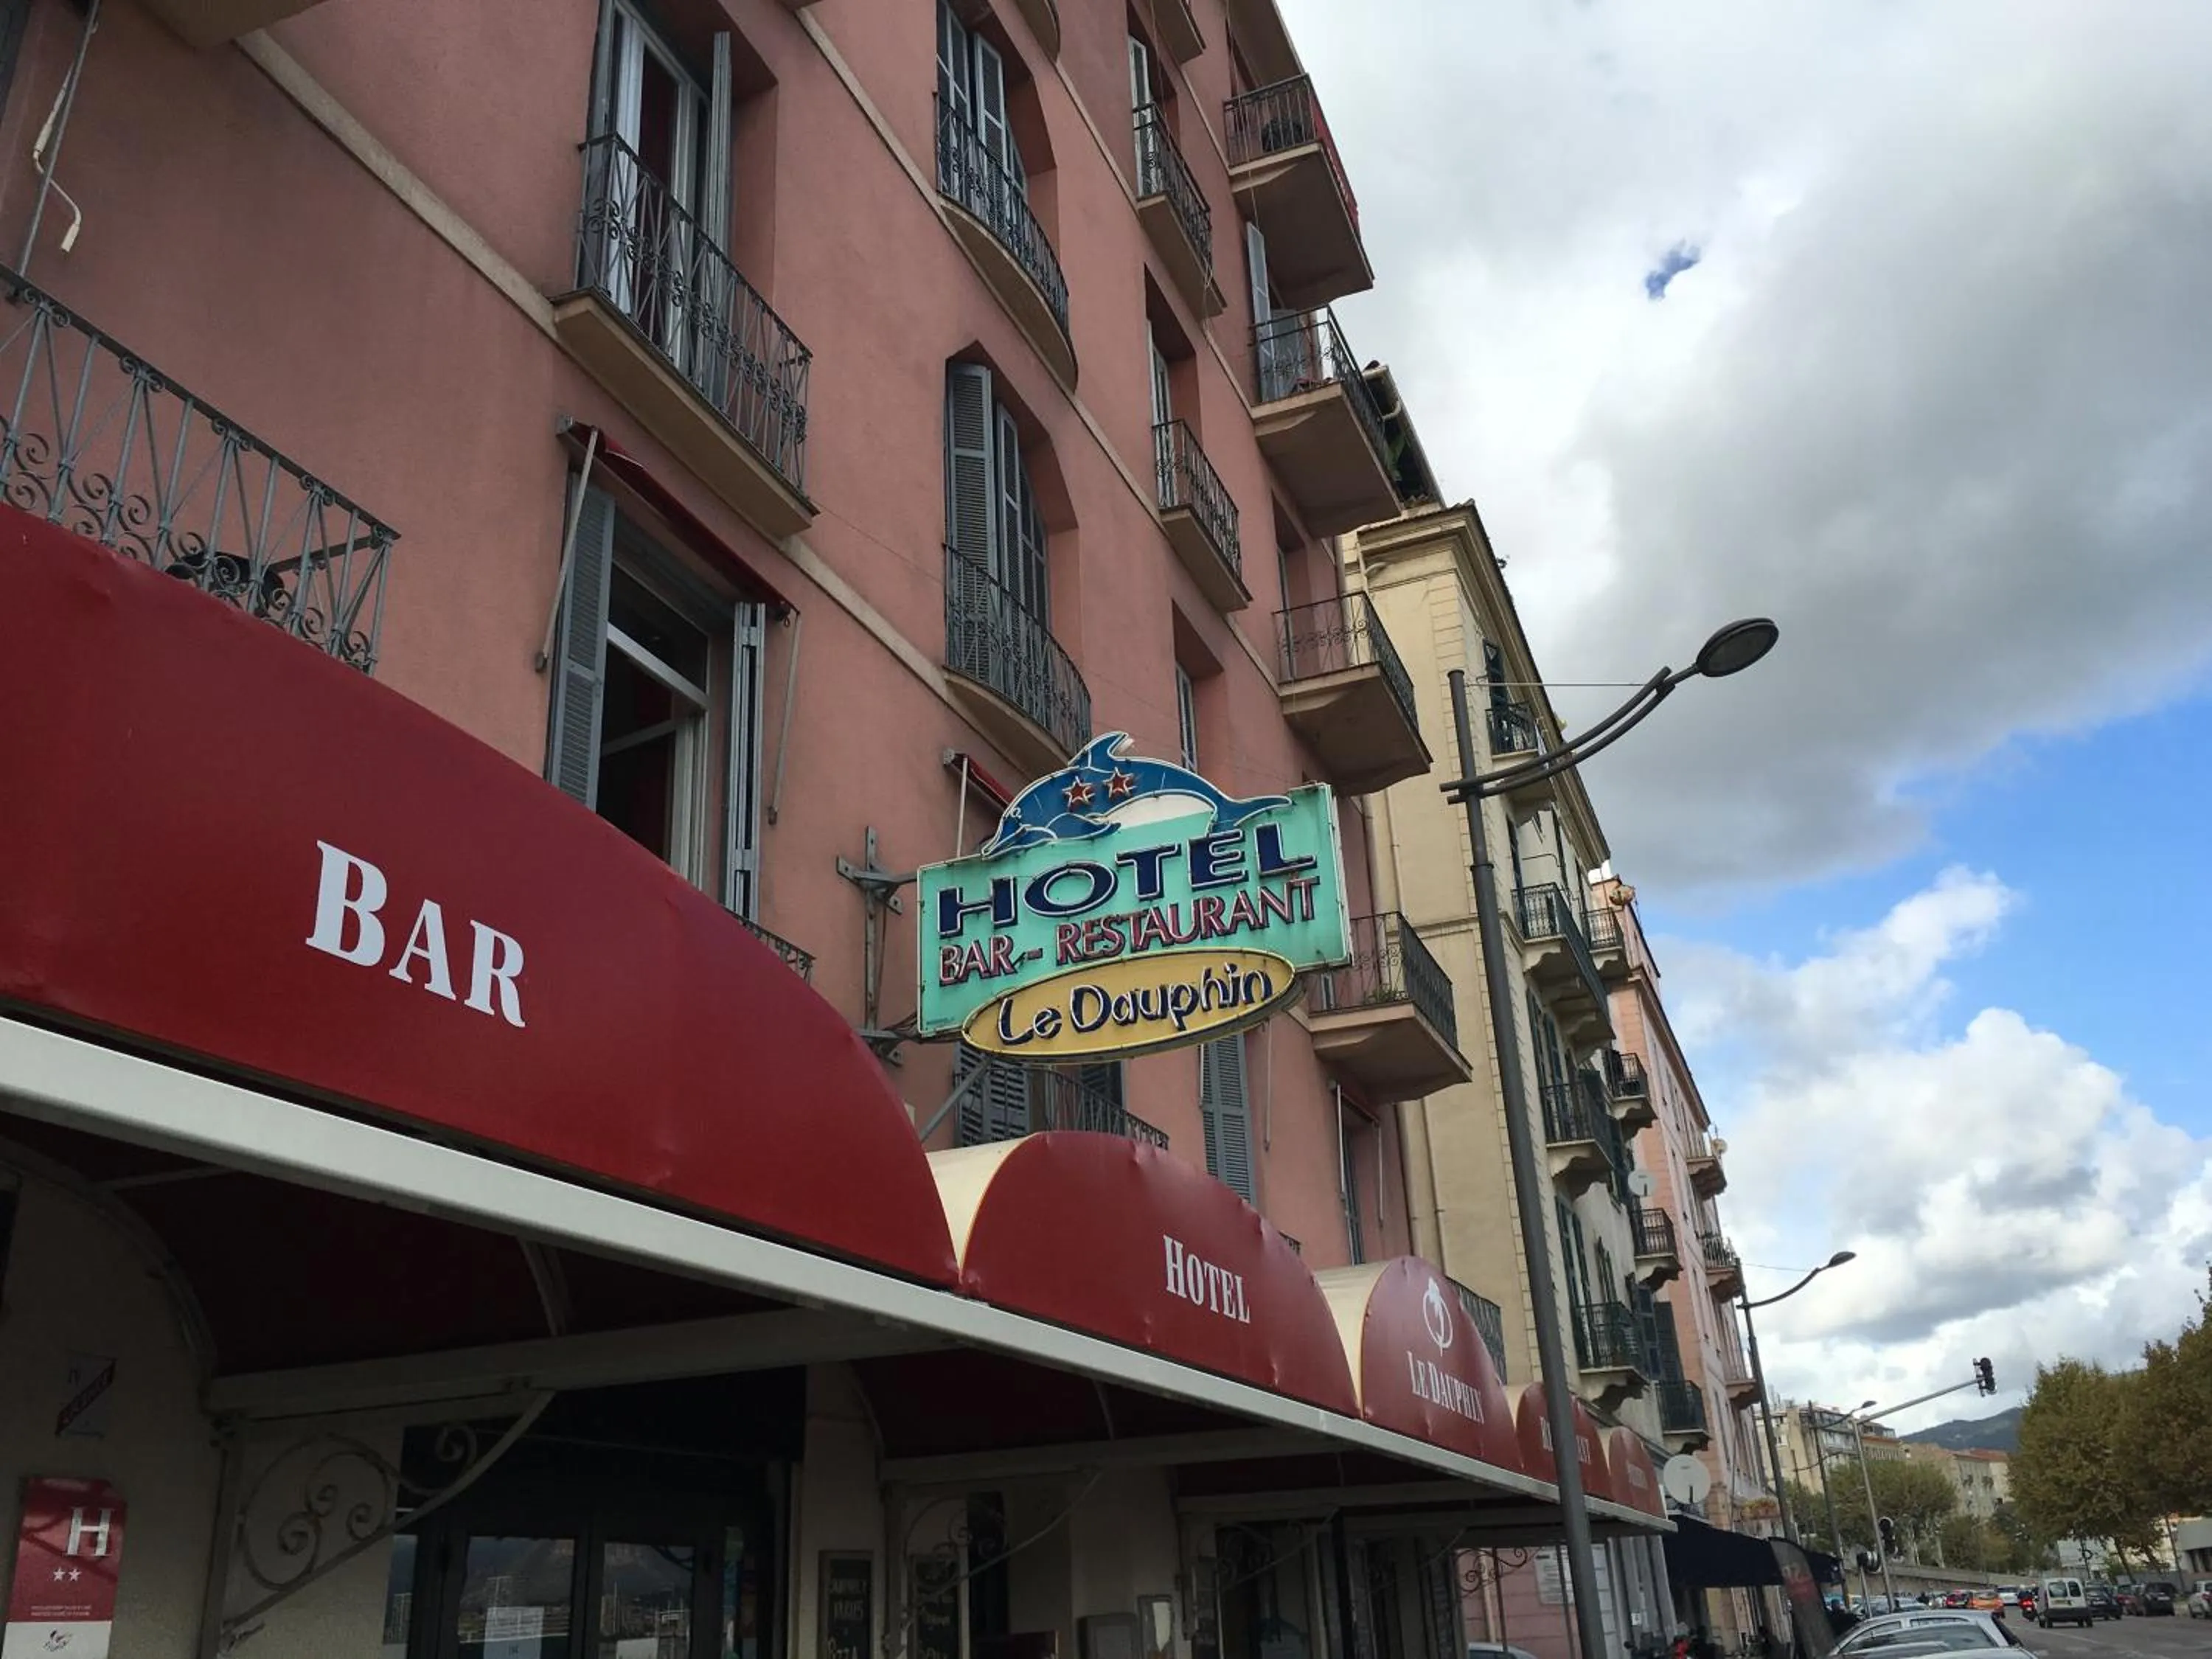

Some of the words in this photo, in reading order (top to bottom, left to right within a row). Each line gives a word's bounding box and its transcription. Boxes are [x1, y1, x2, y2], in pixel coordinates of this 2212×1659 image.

[937, 822, 1319, 937] HOTEL
[1056, 876, 1320, 966] RESTAURANT
[305, 839, 526, 1028] BAR
[997, 998, 1062, 1046] Le
[1070, 962, 1274, 1032] Dauphin
[1163, 1234, 1251, 1324] HOTEL
[1406, 1350, 1428, 1399] LE
[1427, 1360, 1484, 1425] DAUPHIN
[65, 1506, 112, 1557] H
